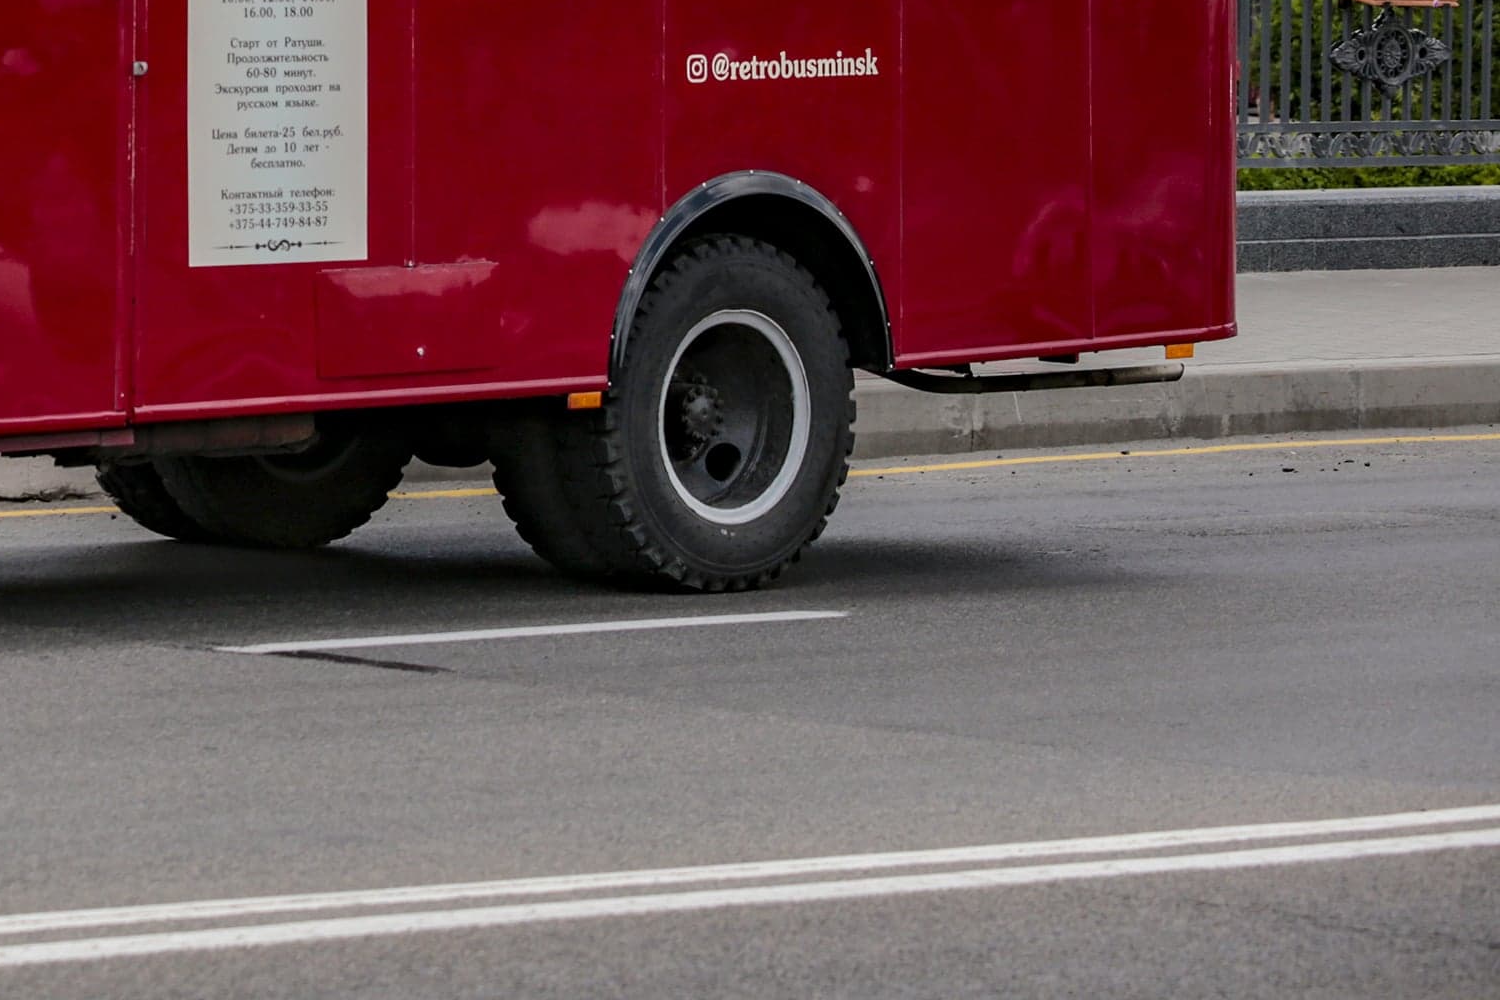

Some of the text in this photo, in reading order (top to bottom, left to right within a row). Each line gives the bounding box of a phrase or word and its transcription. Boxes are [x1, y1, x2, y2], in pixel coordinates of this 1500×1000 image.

[244, 6, 314, 19] 16.00, 18.00
[230, 37, 325, 50] Старт от Ратуши.
[227, 53, 329, 66] Продолжительность
[711, 47, 879, 82] @retrobusminsk
[246, 67, 316, 80] 60-80 минут.
[215, 83, 341, 96] Экскурсия проходит на
[237, 98, 319, 111] русском языке.
[211, 125, 344, 140] Цена билета-25 бел.руб.
[226, 143, 258, 155] Детям
[265, 145, 277, 154] до
[284, 142, 297, 153] 10
[303, 143, 320, 152] лет
[250, 157, 306, 169] бесплатно.
[221, 187, 335, 200] Контактный телефон:
[228, 201, 329, 215] +375-33-359-33-55
[228, 216, 328, 230] +375-44-749-84-87
